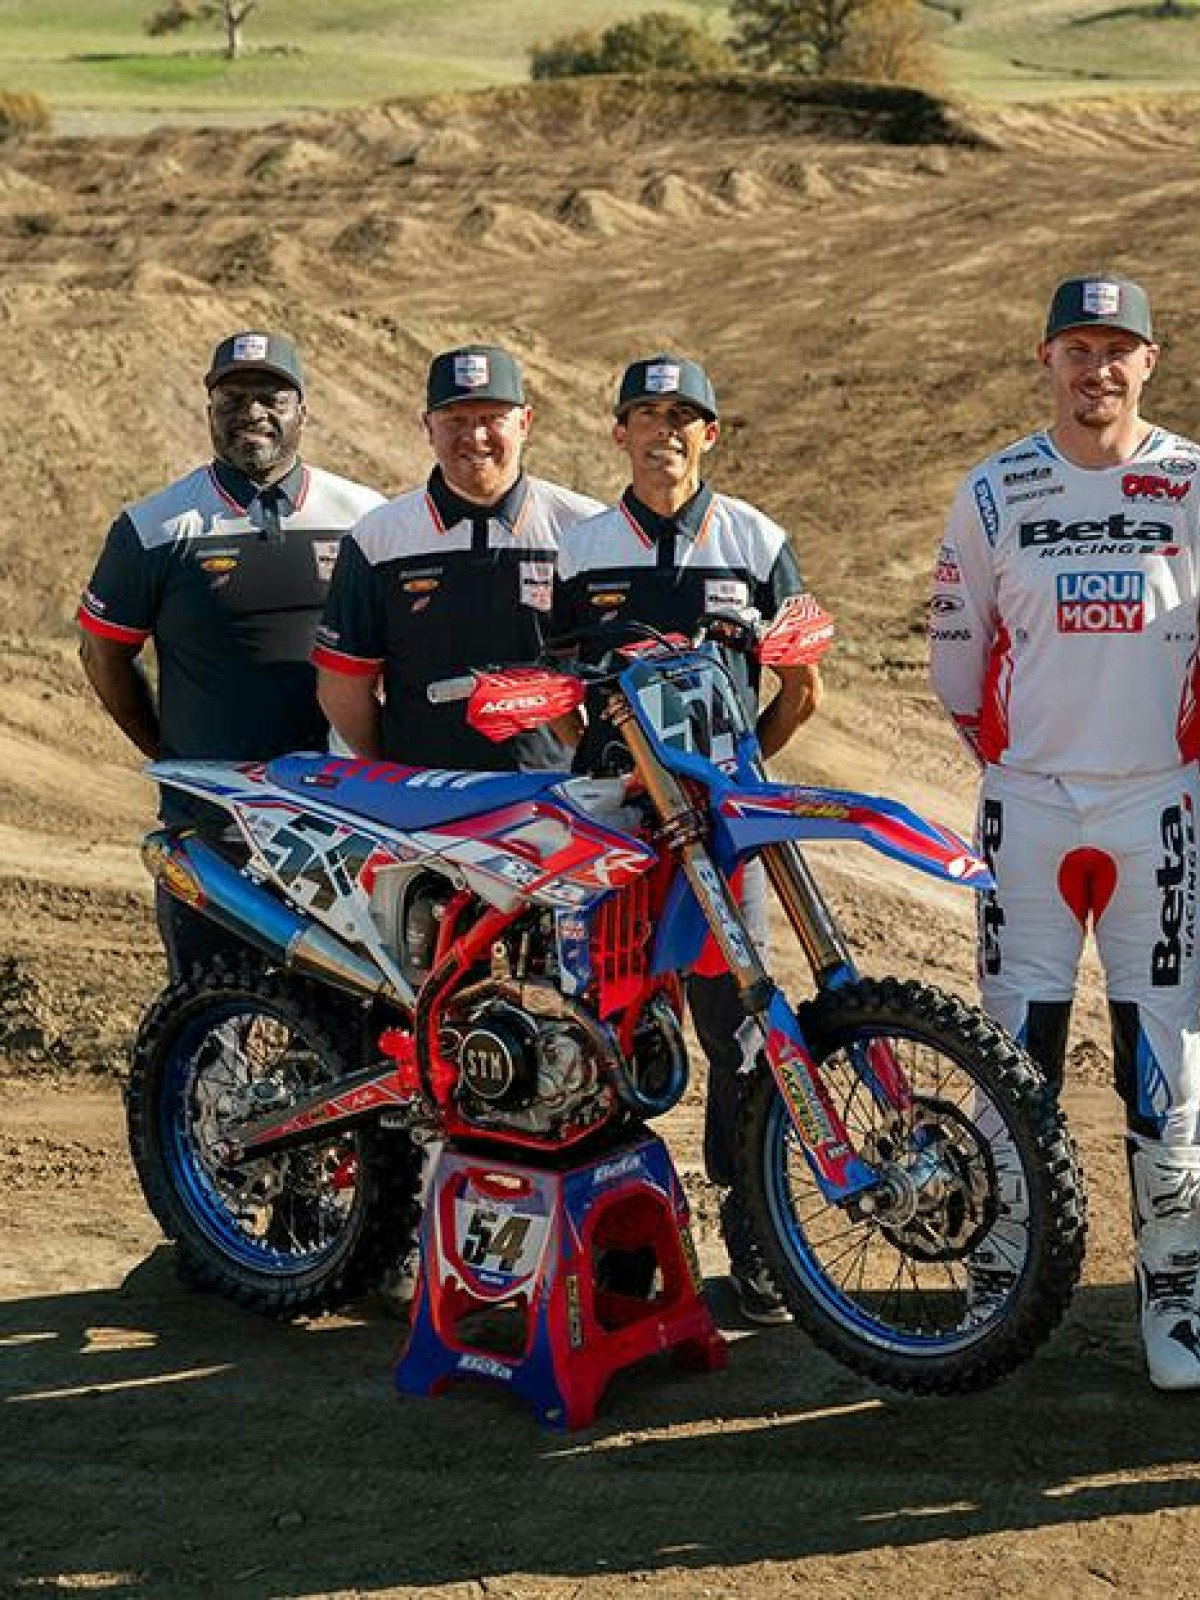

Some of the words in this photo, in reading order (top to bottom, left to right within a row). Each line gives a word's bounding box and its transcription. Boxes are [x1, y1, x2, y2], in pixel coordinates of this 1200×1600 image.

[1020, 513, 1174, 548] Beta
[1039, 544, 1134, 558] RACING
[1060, 575, 1143, 601] LIQUI
[1060, 605, 1142, 631] MOLY
[1152, 804, 1184, 986] Beta
[1184, 850, 1197, 958] RACING
[465, 1050, 513, 1081] STM
[462, 1207, 532, 1272] 54
